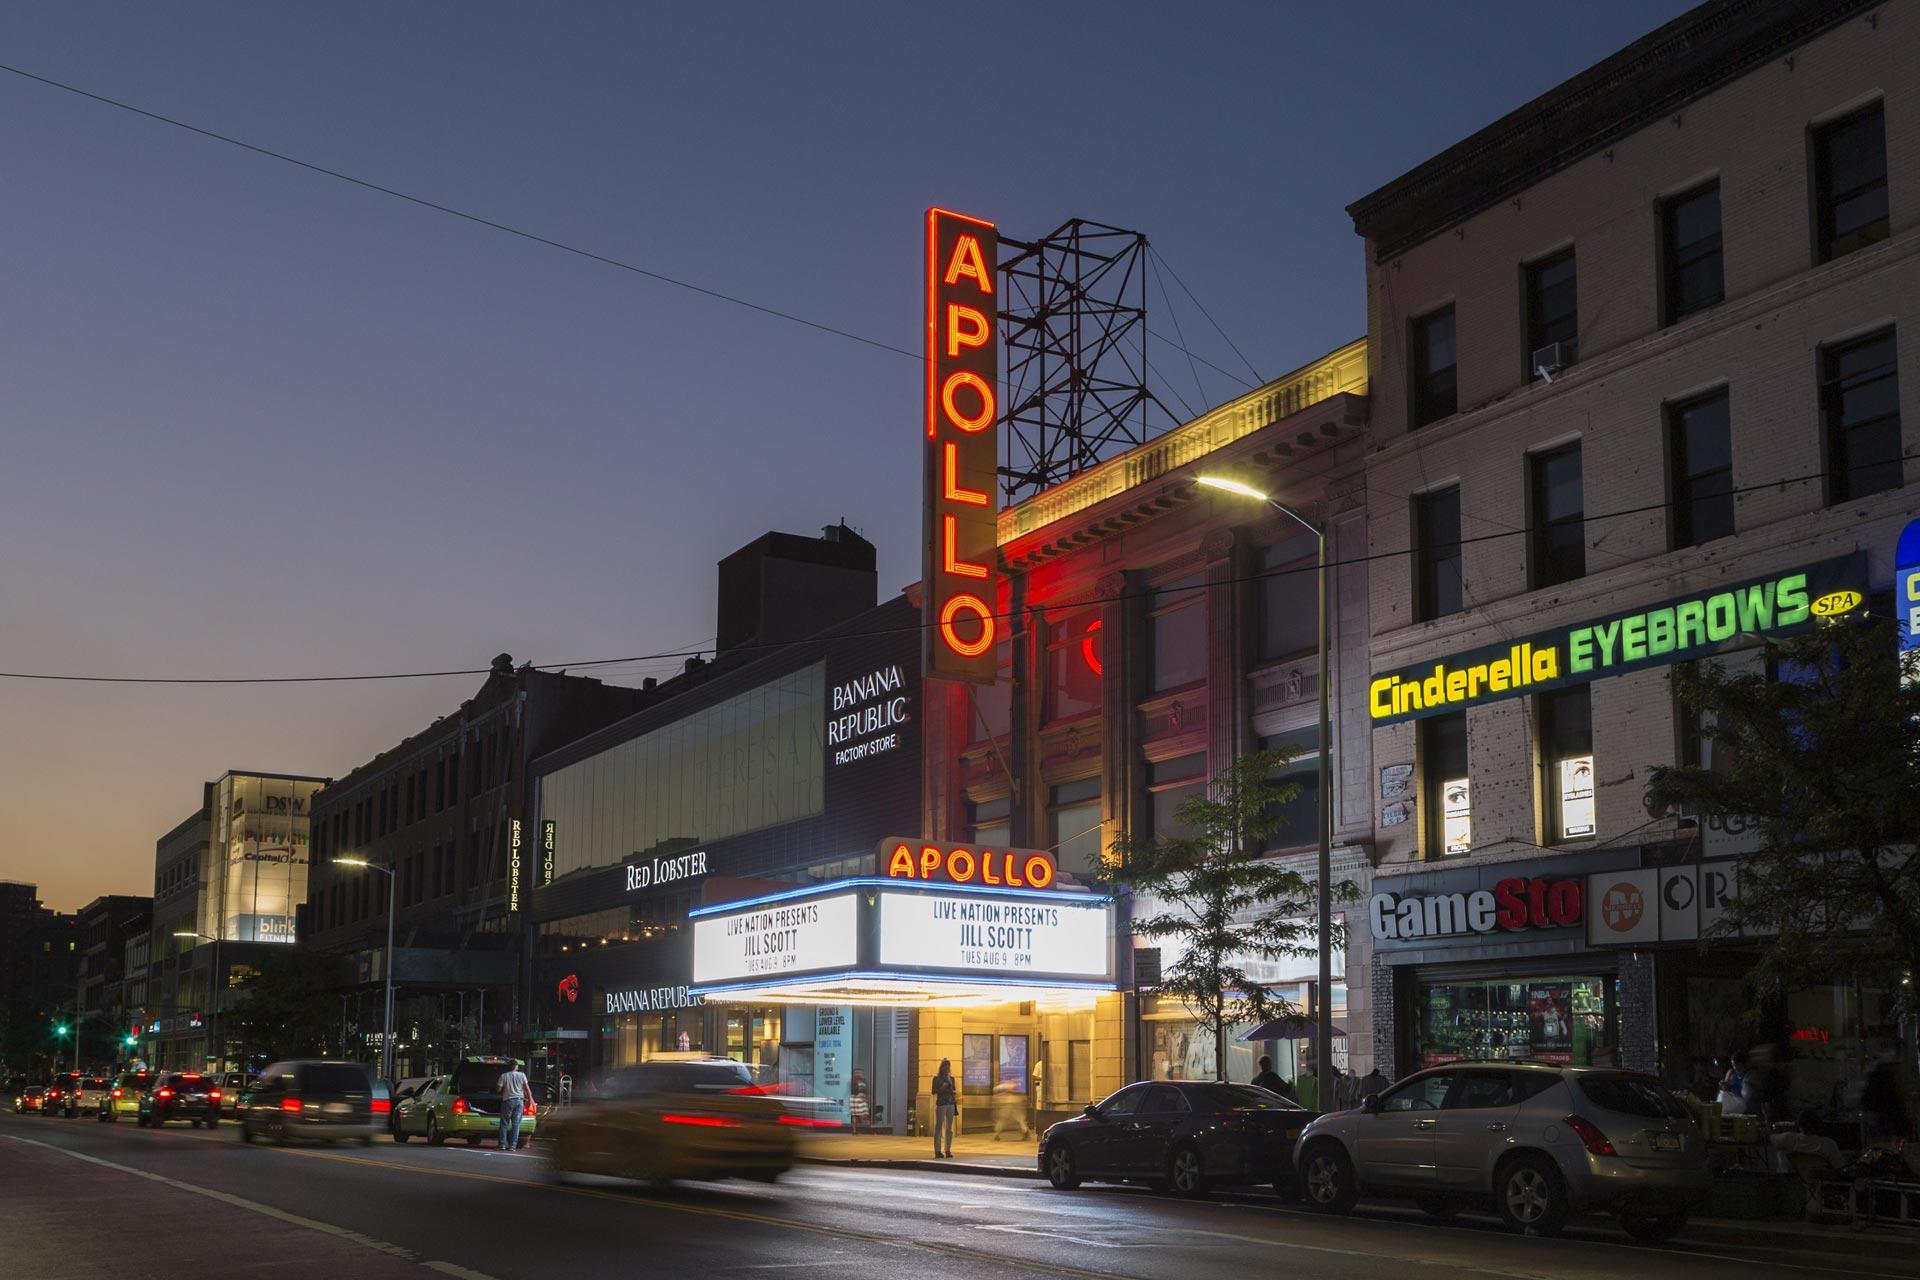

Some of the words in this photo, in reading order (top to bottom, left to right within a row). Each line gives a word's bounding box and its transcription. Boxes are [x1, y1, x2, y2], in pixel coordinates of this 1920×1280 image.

[940, 235, 994, 657] APOLLO
[1817, 593, 1854, 613] SPA
[1569, 573, 1810, 674] EYEBROWS
[833, 665, 901, 711] BANANA
[1370, 642, 1558, 719] Cinderella
[828, 697, 906, 745] REPUBLIC
[835, 742, 869, 765] FACTORY
[870, 733, 896, 754] STORE
[266, 796, 305, 810] DSW
[512, 820, 521, 847] RED
[511, 849, 520, 911] LOBSTER
[626, 865, 650, 891] RED
[652, 852, 707, 885] LOBSTER
[889, 845, 1053, 889] APOLLO
[727, 917, 743, 936] LIVE
[745, 913, 773, 933] NATION
[775, 905, 818, 929] PRESENTS
[933, 901, 957, 919] LIVE
[960, 903, 1000, 923] NATION
[1004, 906, 1058, 927] PRESENTS
[1369, 876, 1585, 940] GameSto
[260, 917, 296, 935] blink
[960, 924, 983, 947] JILL
[988, 926, 1032, 950] SCOTT
[744, 935, 760, 956] JILL
[763, 929, 798, 954] SCOTT
[961, 950, 981, 965] TUES
[983, 951, 1000, 965] AUG
[1002, 952, 1007, 966] 9
[1014, 953, 1032, 966] 8PM
[783, 955, 797, 969] 8PM
[606, 989, 649, 1014] BANANA
